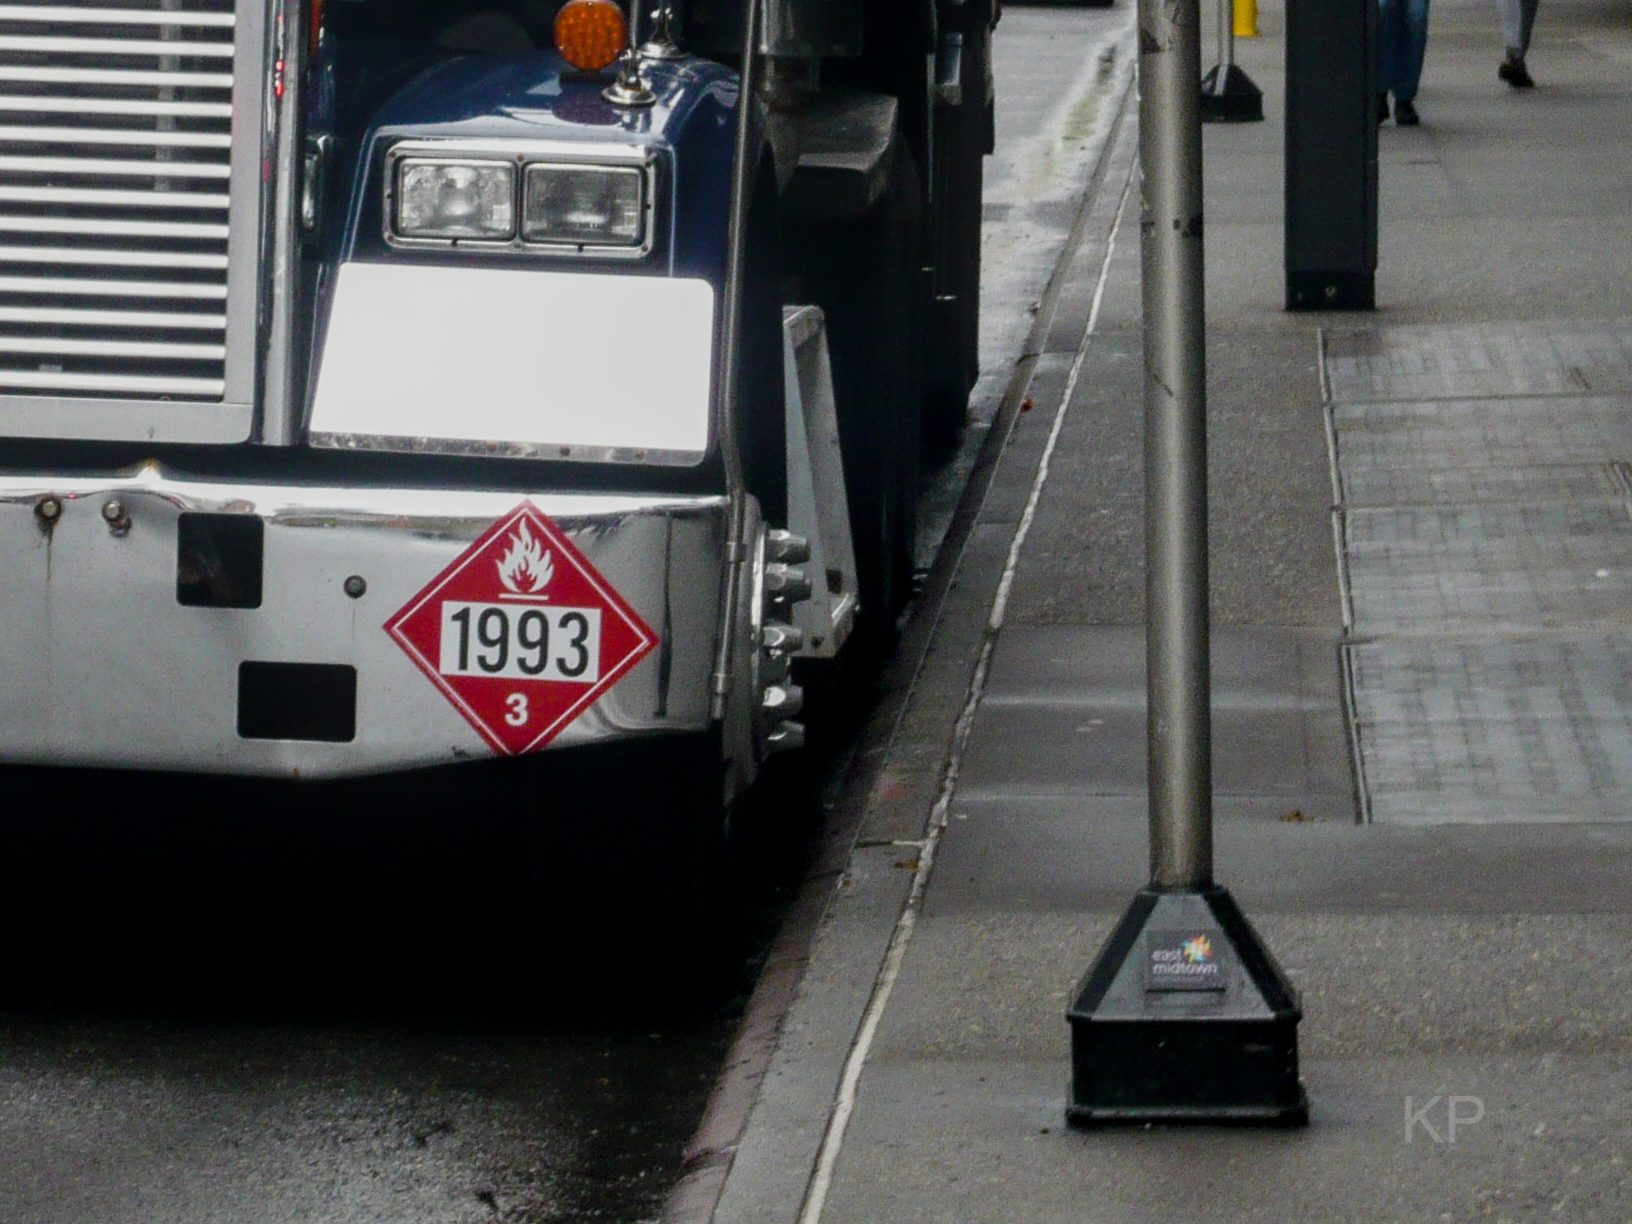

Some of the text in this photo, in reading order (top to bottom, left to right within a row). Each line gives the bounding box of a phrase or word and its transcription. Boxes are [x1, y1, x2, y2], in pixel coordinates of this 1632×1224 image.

[450, 606, 590, 677] 1993
[504, 692, 529, 727] 3
[1153, 961, 1219, 975] midtown
